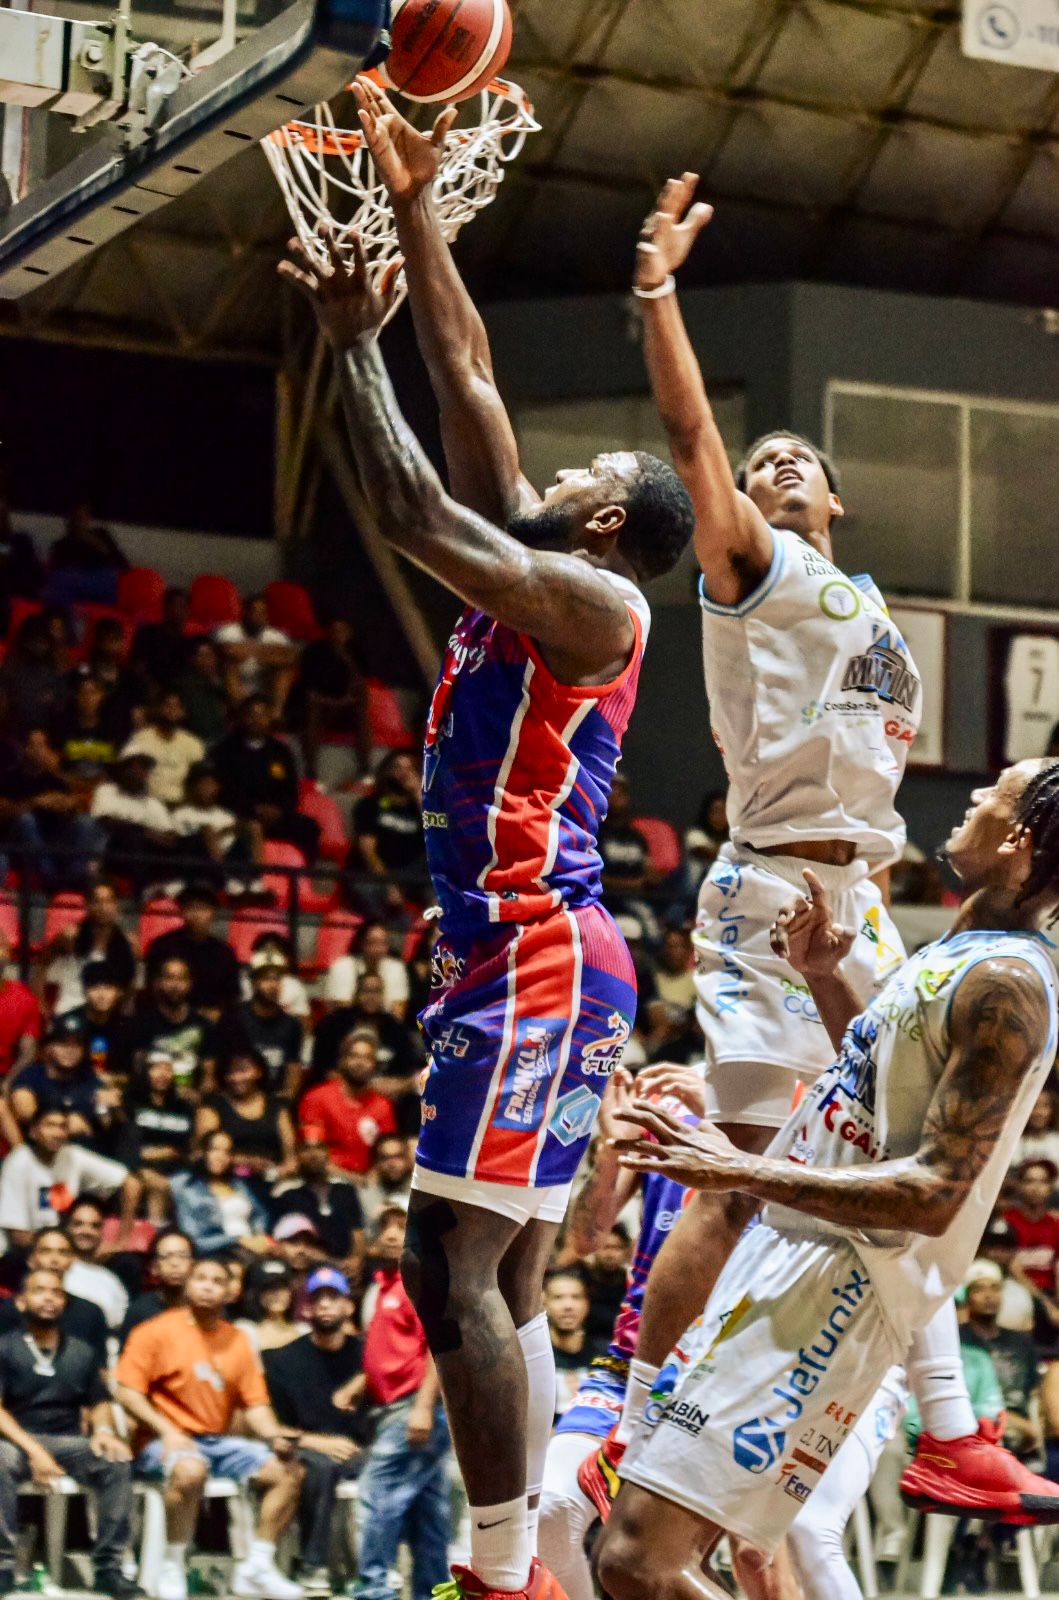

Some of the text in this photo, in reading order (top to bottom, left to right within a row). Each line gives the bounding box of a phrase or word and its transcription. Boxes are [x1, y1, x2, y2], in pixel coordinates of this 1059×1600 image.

[504, 1025, 547, 1123] FRANKLIN
[522, 1079, 543, 1125] SENADOR
[771, 1269, 871, 1420] Jefunix
